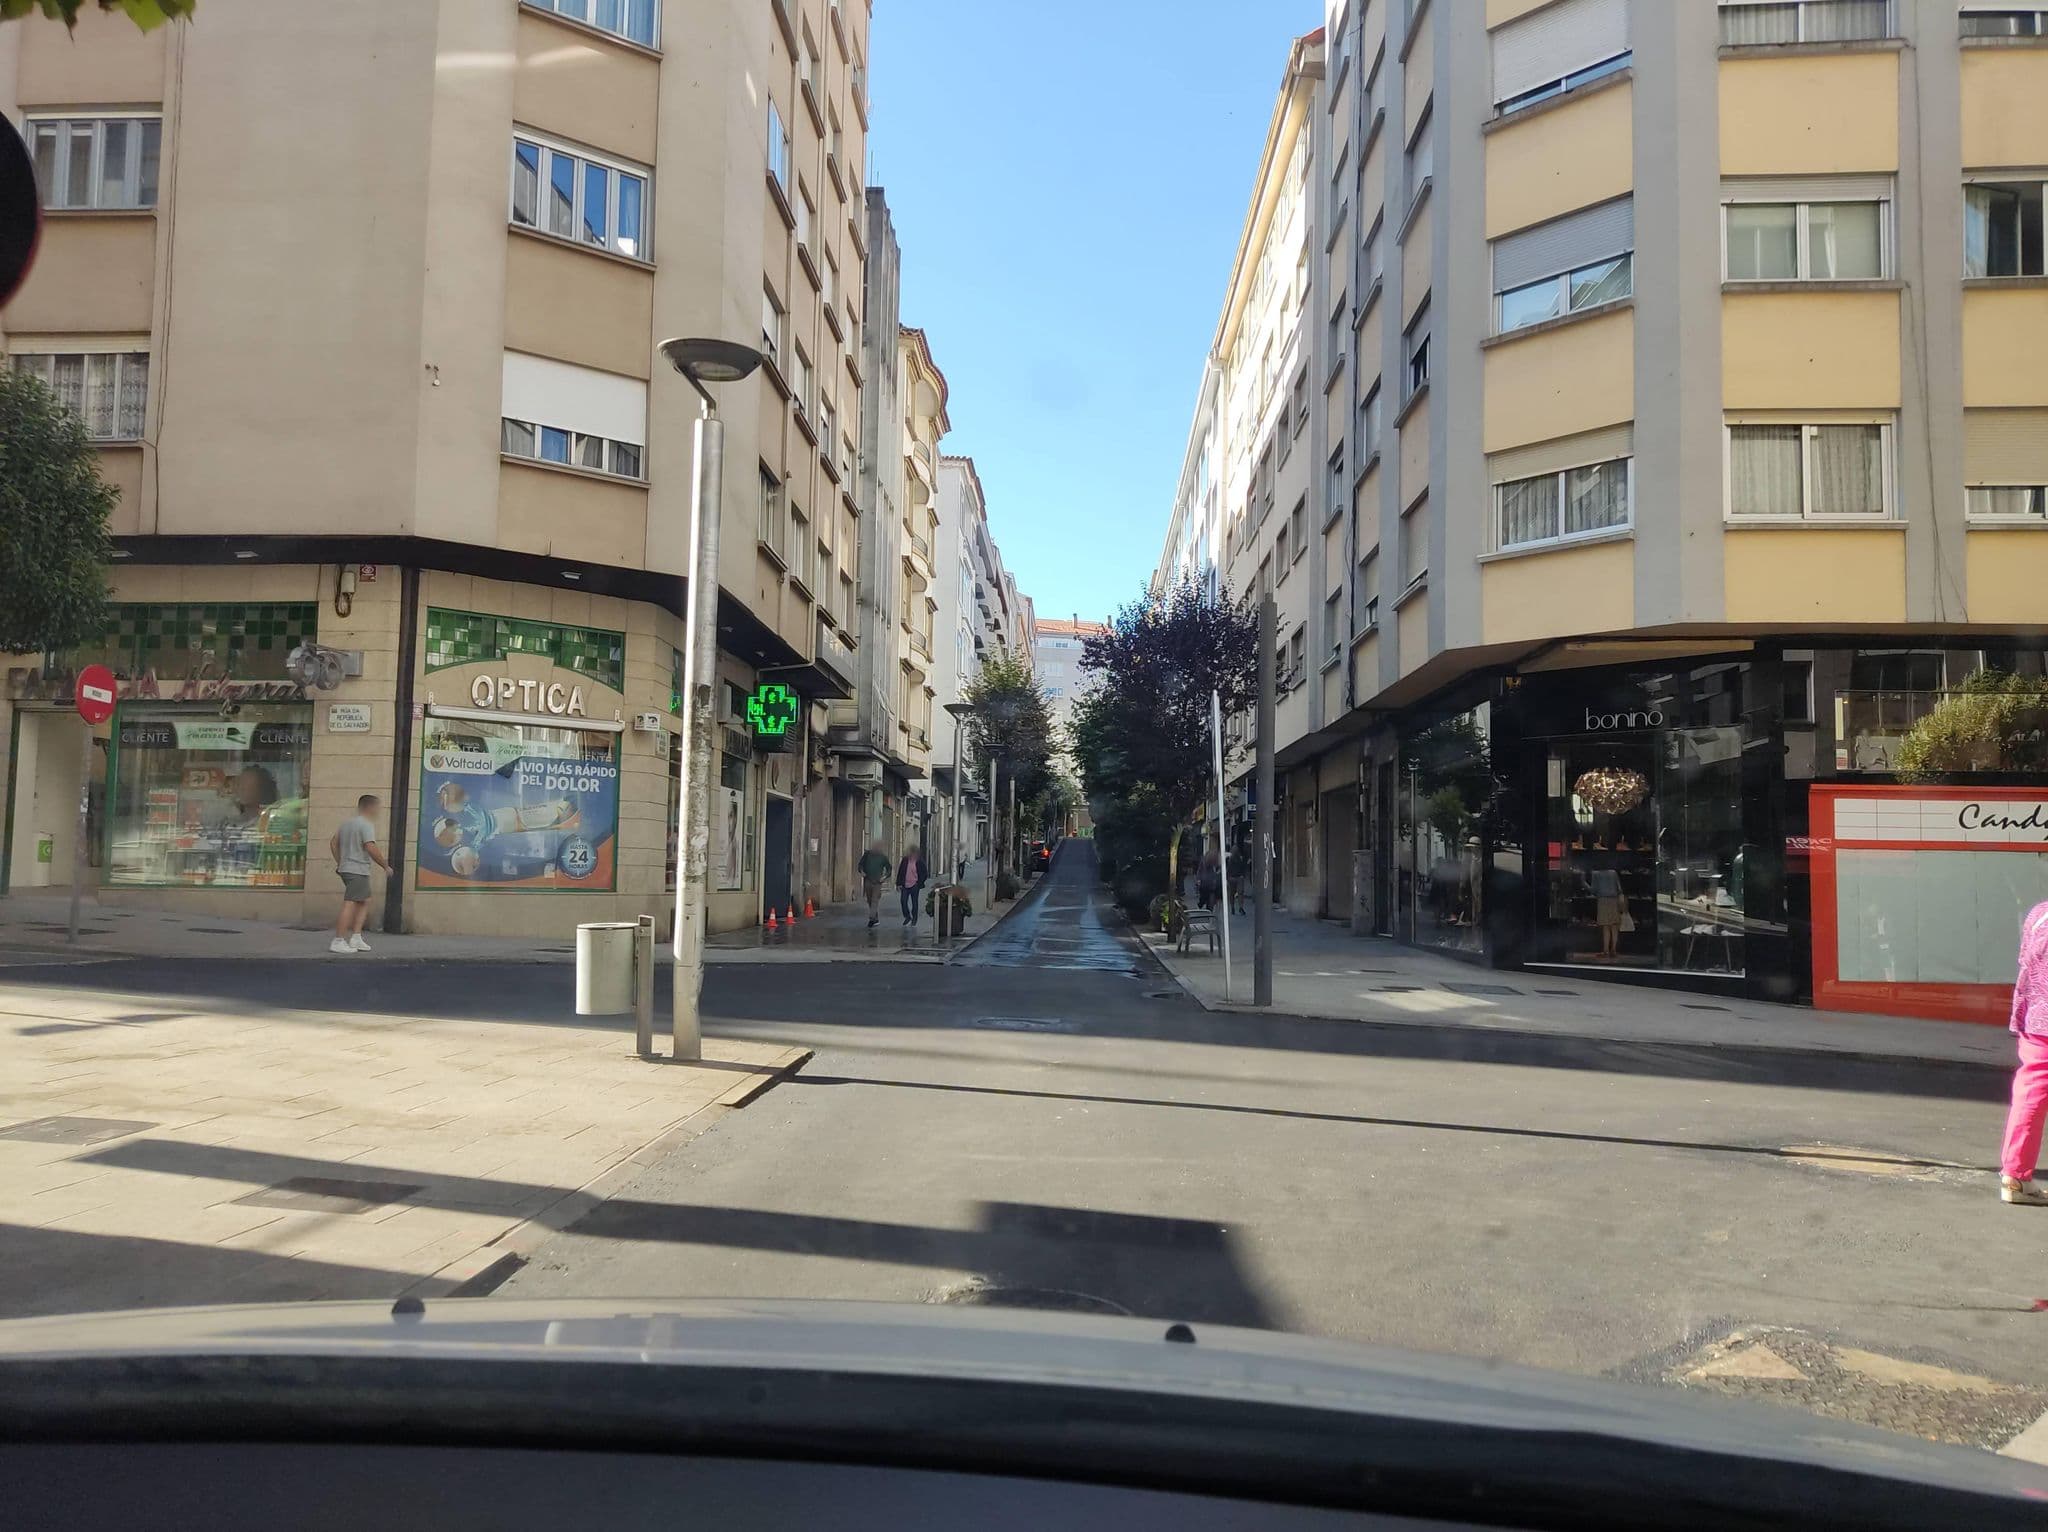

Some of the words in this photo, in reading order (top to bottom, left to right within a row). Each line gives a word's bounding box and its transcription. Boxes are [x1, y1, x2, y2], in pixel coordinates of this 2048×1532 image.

[472, 675, 587, 716] OPTICA
[1586, 707, 1663, 730] bonino
[259, 730, 310, 744] CLIENTE
[445, 756, 493, 771] Voltadol
[546, 761, 573, 775] MÁS
[574, 763, 617, 778] RÁPIDO
[520, 774, 543, 786] DEL
[545, 775, 600, 793] DOLOR
[569, 850, 589, 864] 24
